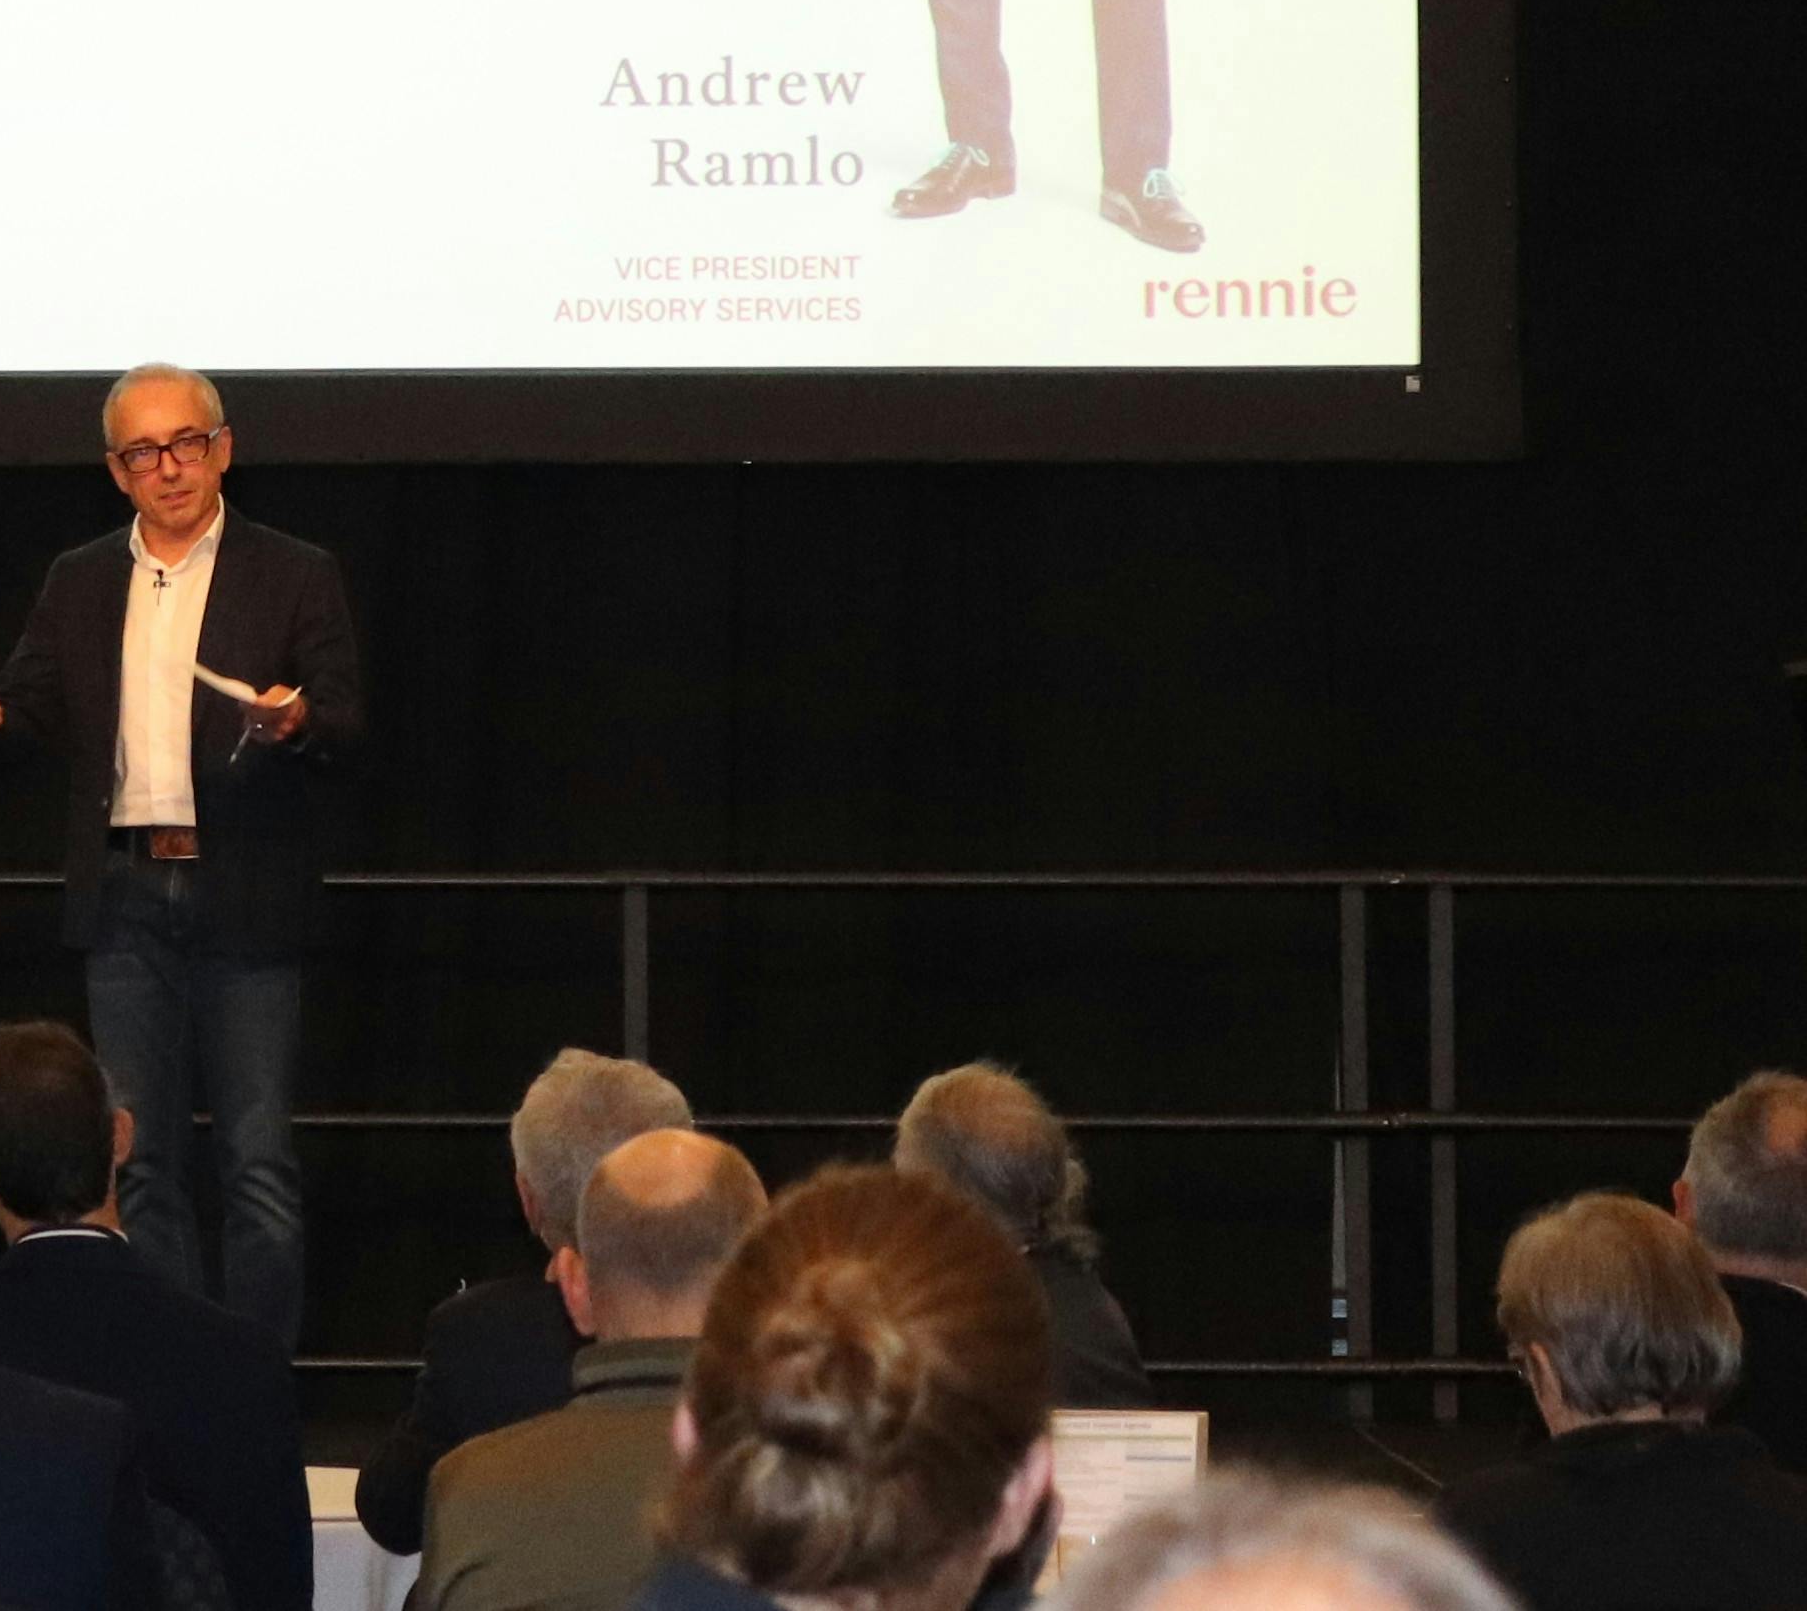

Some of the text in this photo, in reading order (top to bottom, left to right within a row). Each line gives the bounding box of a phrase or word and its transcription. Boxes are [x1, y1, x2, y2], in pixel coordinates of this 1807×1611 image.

[600, 56, 867, 108] Andrew
[651, 134, 866, 188] Ramlo
[614, 256, 862, 282] VICE PRESIDENT
[1143, 265, 1359, 320] rennie
[553, 297, 864, 325] ADVISORY SERVICES
